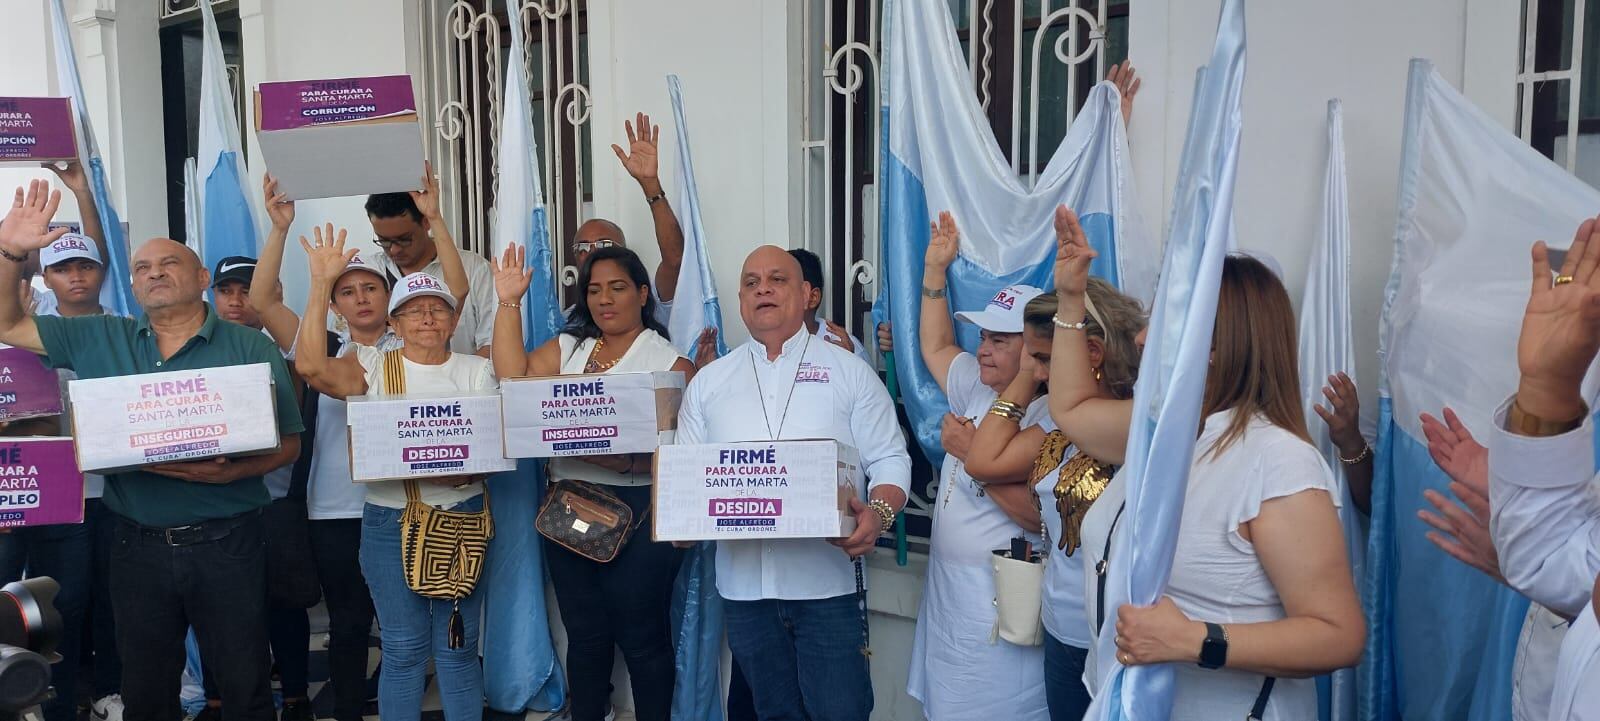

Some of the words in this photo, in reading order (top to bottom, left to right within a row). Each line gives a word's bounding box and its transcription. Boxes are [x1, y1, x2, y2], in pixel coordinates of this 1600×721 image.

[302, 104, 376, 116] CORRUPCIÓN
[407, 278, 443, 289] CURA
[993, 291, 1015, 305] RA
[798, 371, 829, 379] CURA
[141, 374, 207, 398] FIRMÉ
[553, 378, 604, 397] FIRMÉ
[127, 400, 163, 412] PARA
[166, 393, 210, 407] CURAR
[213, 392, 223, 401] A
[541, 400, 569, 408] PARA
[571, 397, 606, 406] CURAR
[608, 396, 616, 404] A
[128, 410, 174, 424] SANTA
[178, 404, 225, 417] MARTA
[410, 401, 461, 419] FIRMÉ
[542, 410, 577, 419] SANTA
[580, 407, 617, 416] MARTA
[397, 420, 426, 428] PARA
[428, 419, 463, 427] CURAR
[134, 426, 224, 446] INSEGURIDAD
[398, 430, 433, 438] SANTA
[437, 428, 473, 436] MARTA
[545, 428, 615, 440] INSEGURIDAD
[174, 441, 216, 452] ALFREDO
[408, 447, 464, 460] DESIDIA
[720, 445, 776, 464] FIRMÉ
[28, 466, 38, 475] A
[705, 467, 736, 475] PARA
[738, 466, 777, 475] CURAR
[780, 466, 788, 474] A
[705, 478, 744, 487] SANTA
[747, 477, 788, 487] MARTA
[715, 501, 776, 514] DESIDIA
